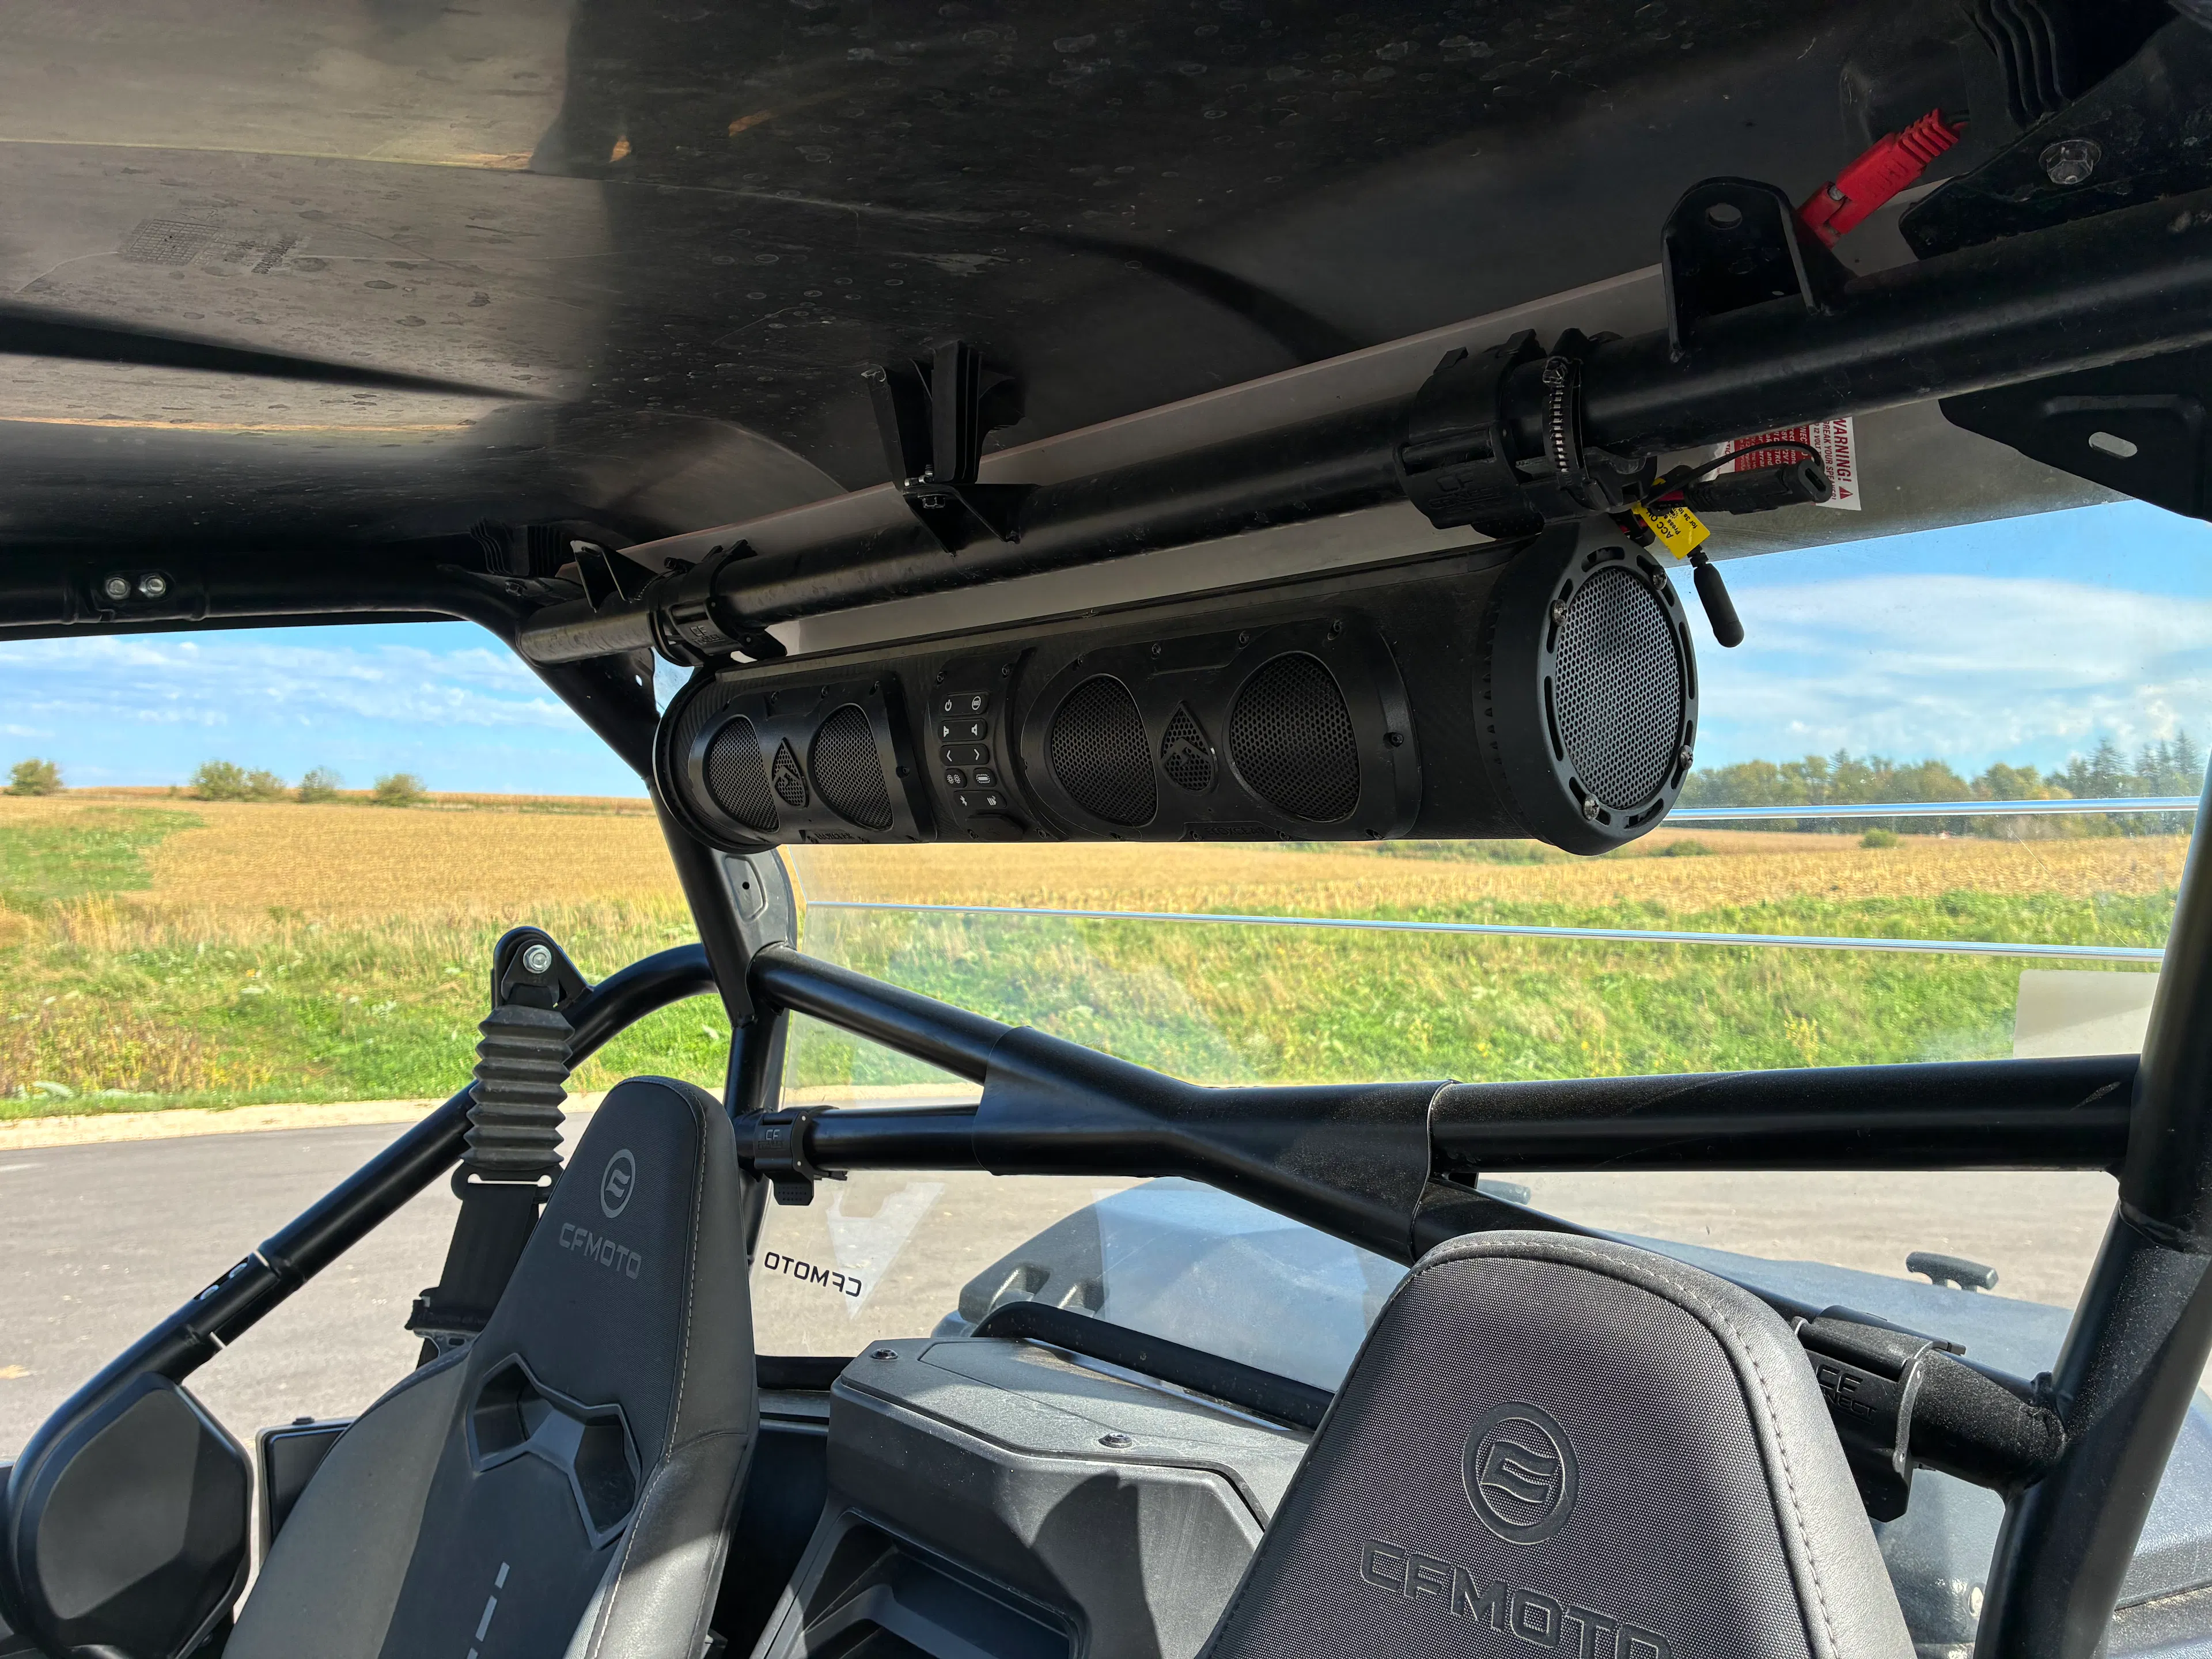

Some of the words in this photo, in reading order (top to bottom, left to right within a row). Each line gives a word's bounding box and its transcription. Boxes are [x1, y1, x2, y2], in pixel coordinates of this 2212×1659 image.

[1824, 446, 1833, 464] YOUR
[1656, 521, 1674, 539] ACC
[1667, 519, 1681, 535] Press
[1688, 520, 1698, 529] for
[765, 1129, 781, 1141] CF
[559, 1222, 642, 1279] CFMOTO
[1822, 1388, 1879, 1419] NECT
[1360, 1540, 1671, 1659] CFMOTO
